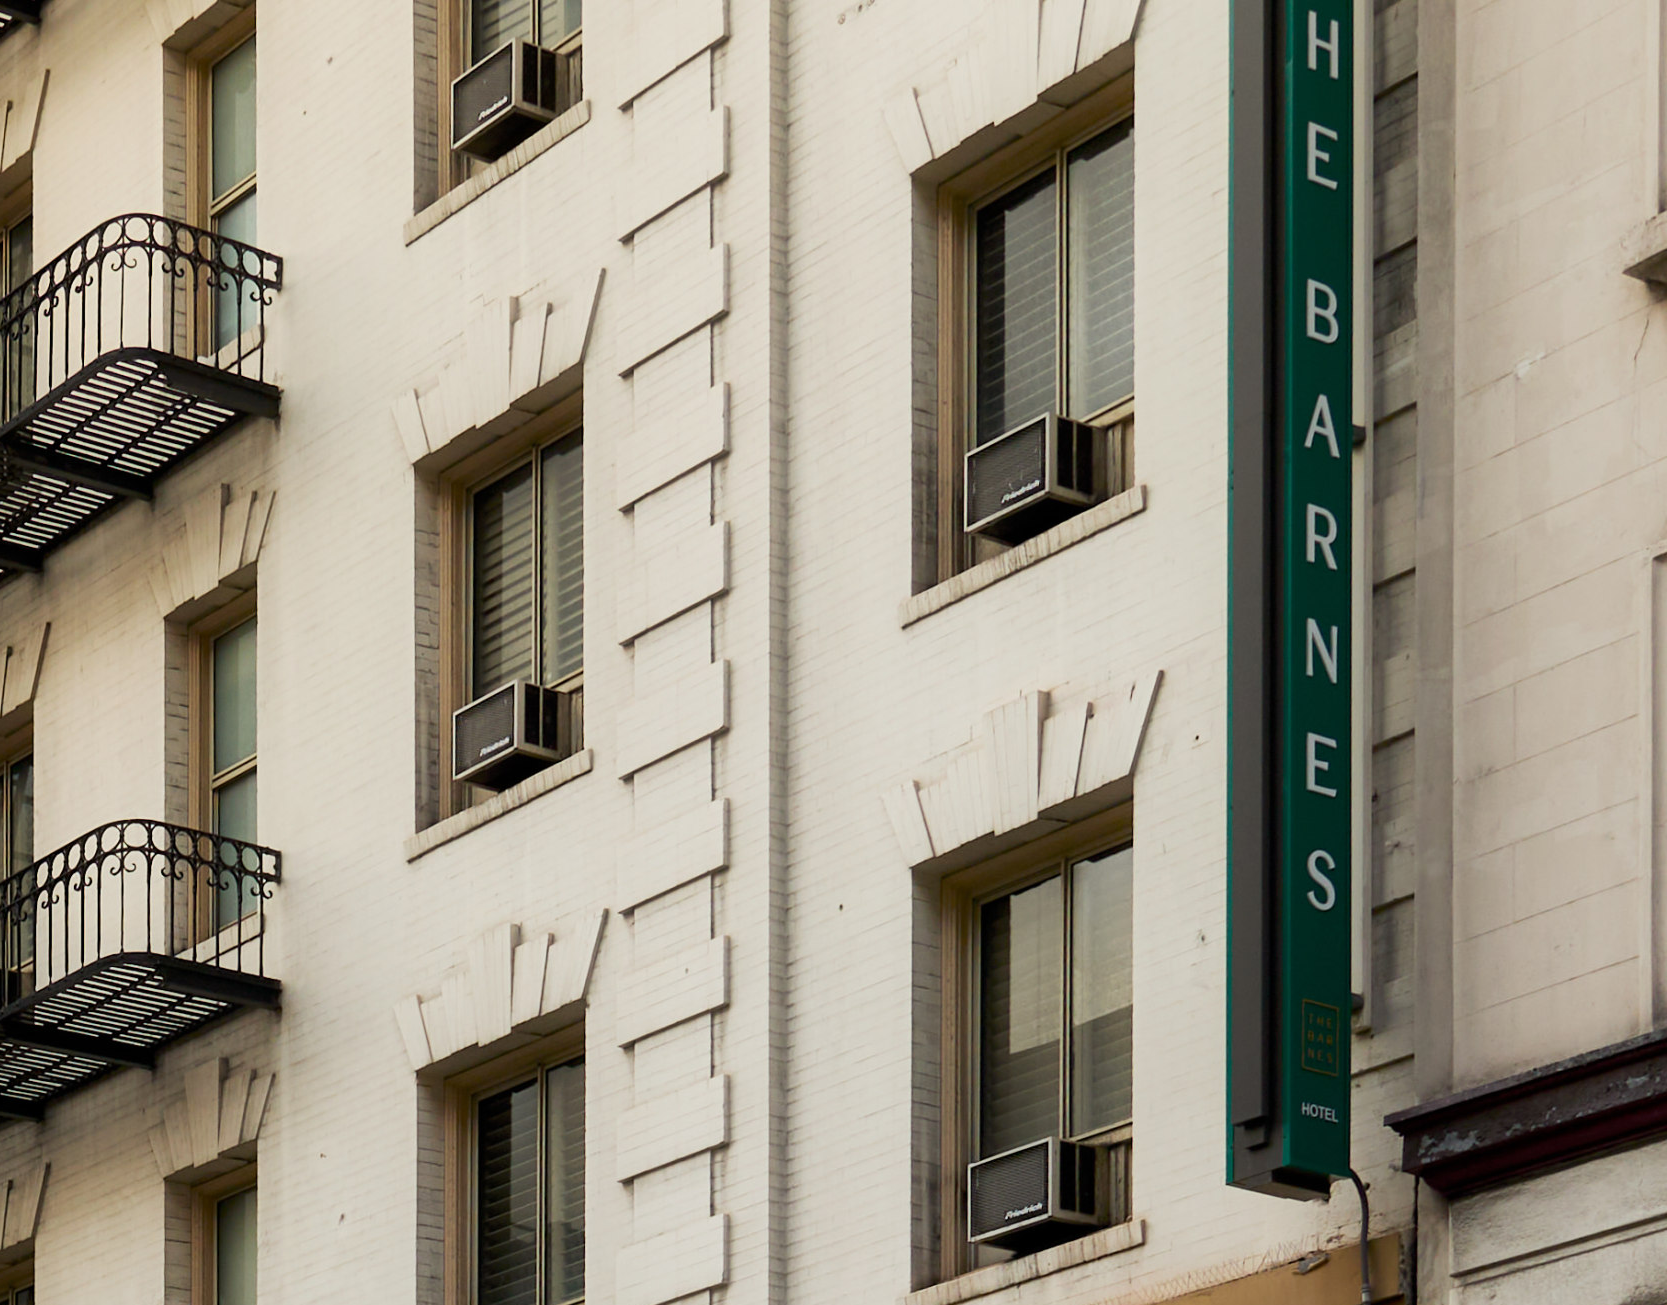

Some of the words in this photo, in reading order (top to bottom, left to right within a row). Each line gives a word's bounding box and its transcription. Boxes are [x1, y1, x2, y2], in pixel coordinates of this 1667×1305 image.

[1307, 0, 1341, 191] HE
[1306, 278, 1341, 912] BARNES
[1302, 1102, 1339, 1123] HOTEL
